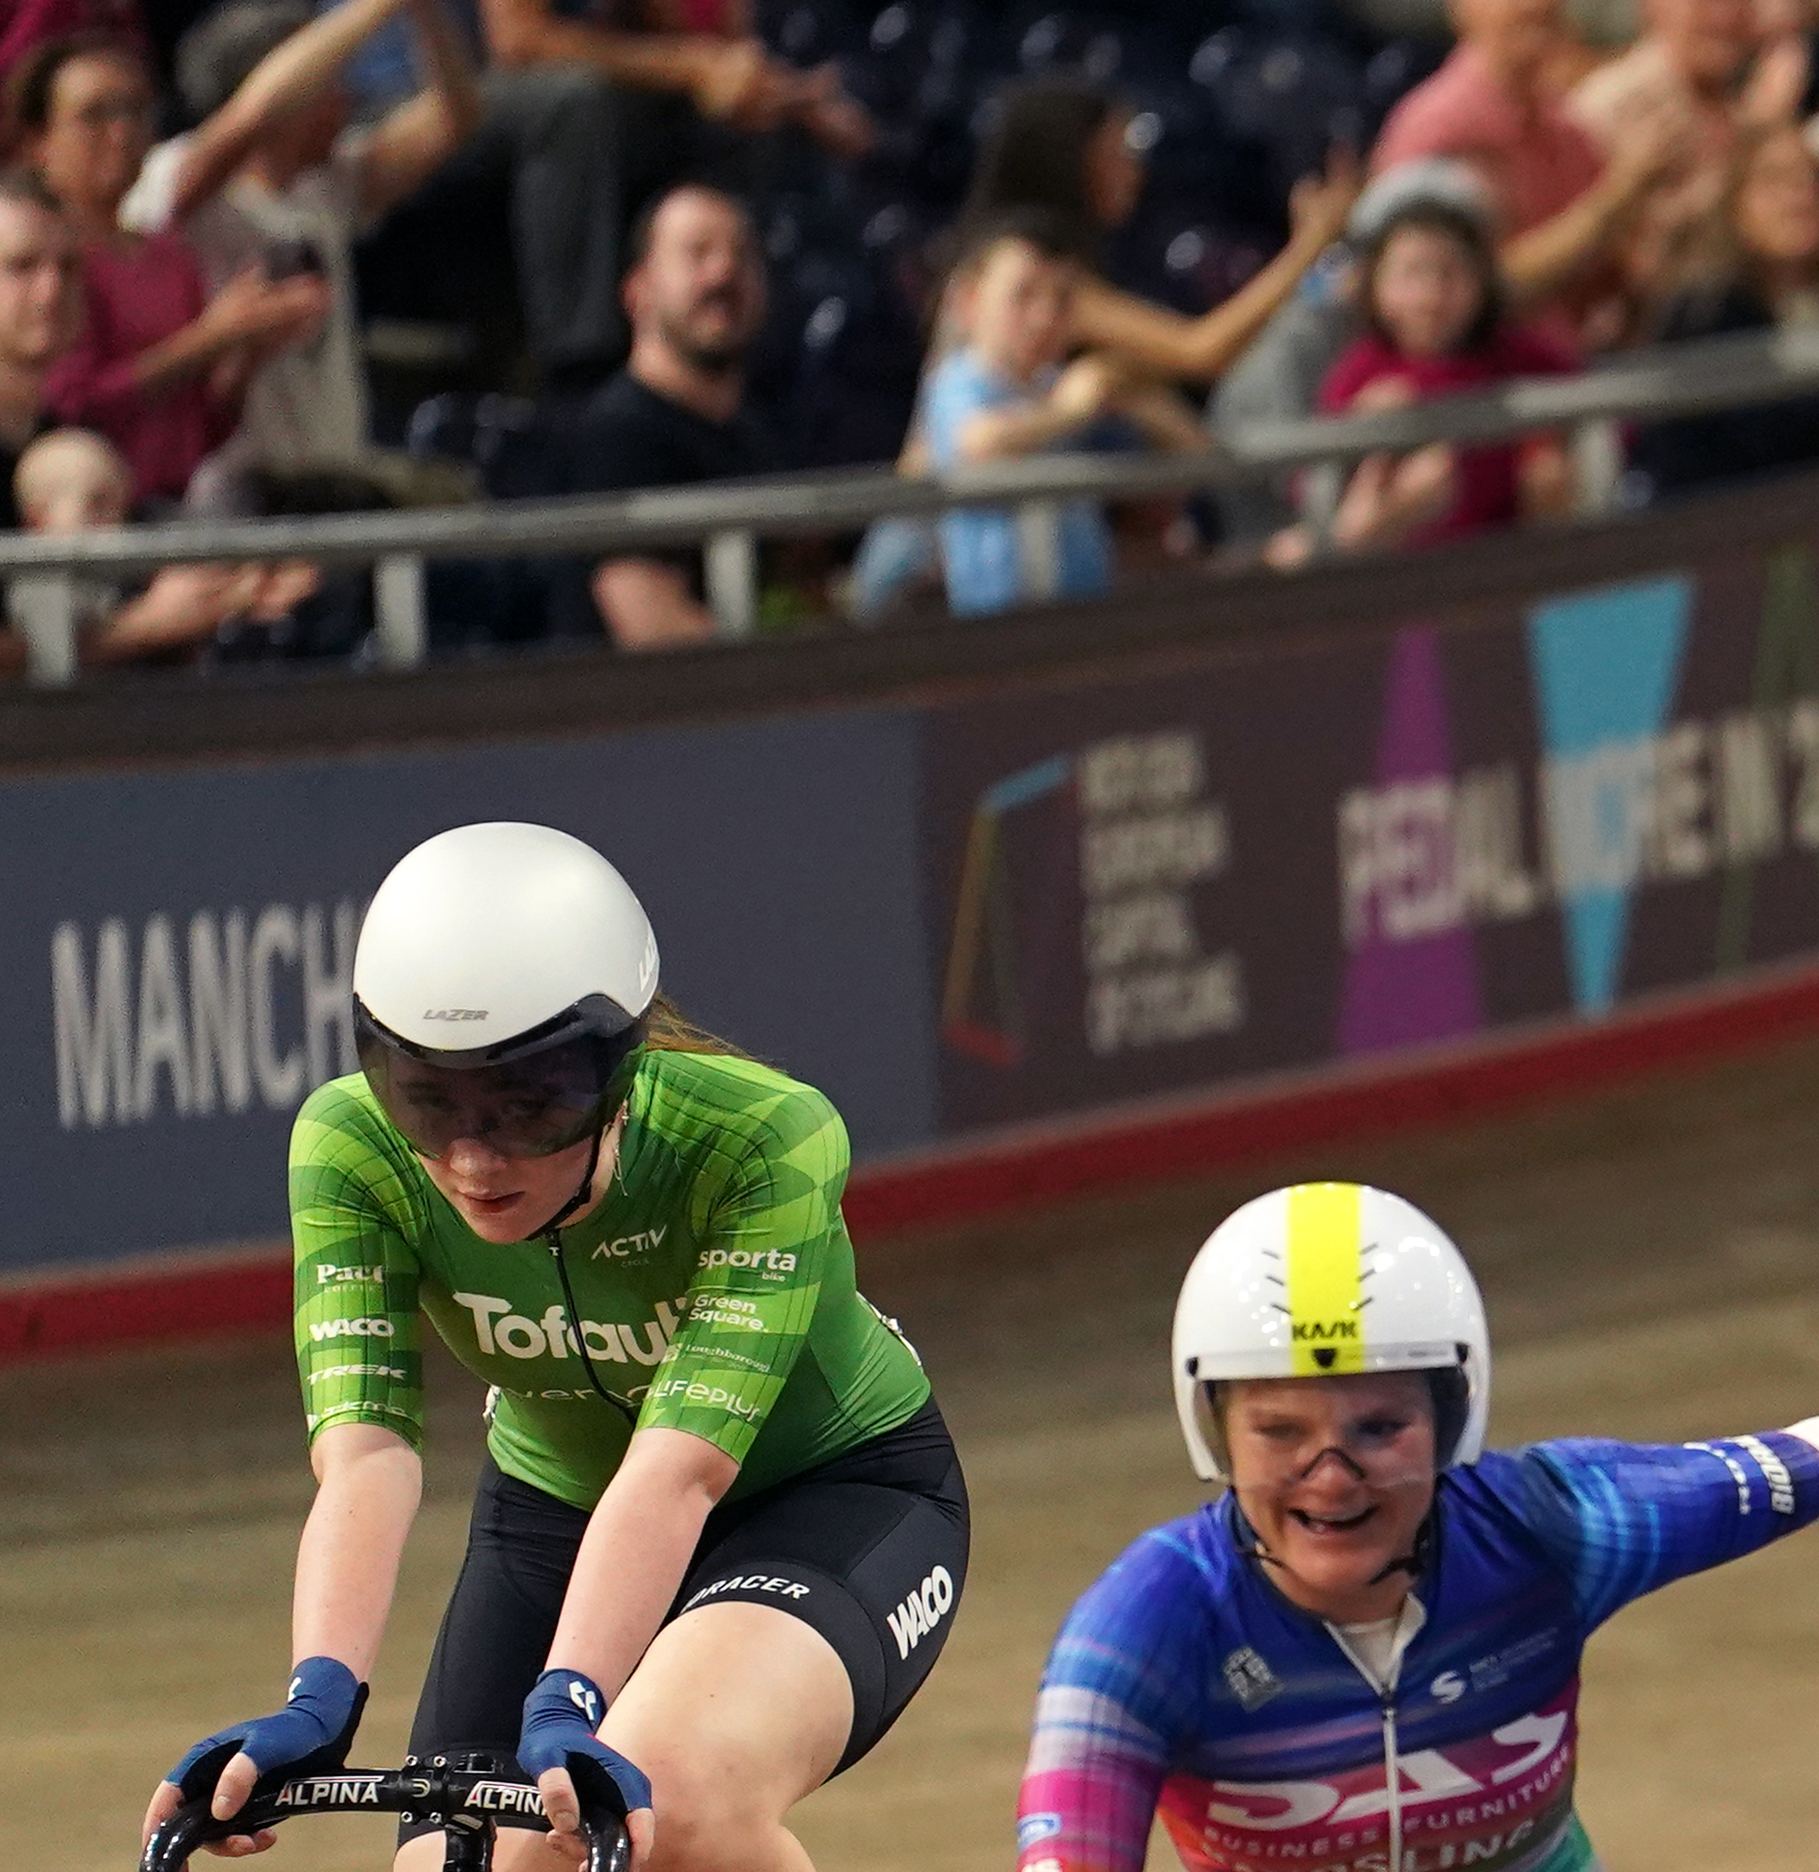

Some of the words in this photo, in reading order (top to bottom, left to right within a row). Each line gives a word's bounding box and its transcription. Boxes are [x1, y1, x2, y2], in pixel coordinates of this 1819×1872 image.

[422, 1008, 490, 1022] LAZER
[591, 1224, 668, 1260] ACTIV
[698, 1249, 797, 1272] sporta
[762, 1272, 787, 1283] bike
[695, 1294, 757, 1314] Green
[309, 1318, 395, 1341] WACO
[452, 1290, 688, 1366] Tofaut
[306, 1364, 408, 1385] TREK
[886, 1564, 953, 1660] WACO
[274, 1775, 385, 1806] ALPINA
[464, 1780, 549, 1816] ALPIN
